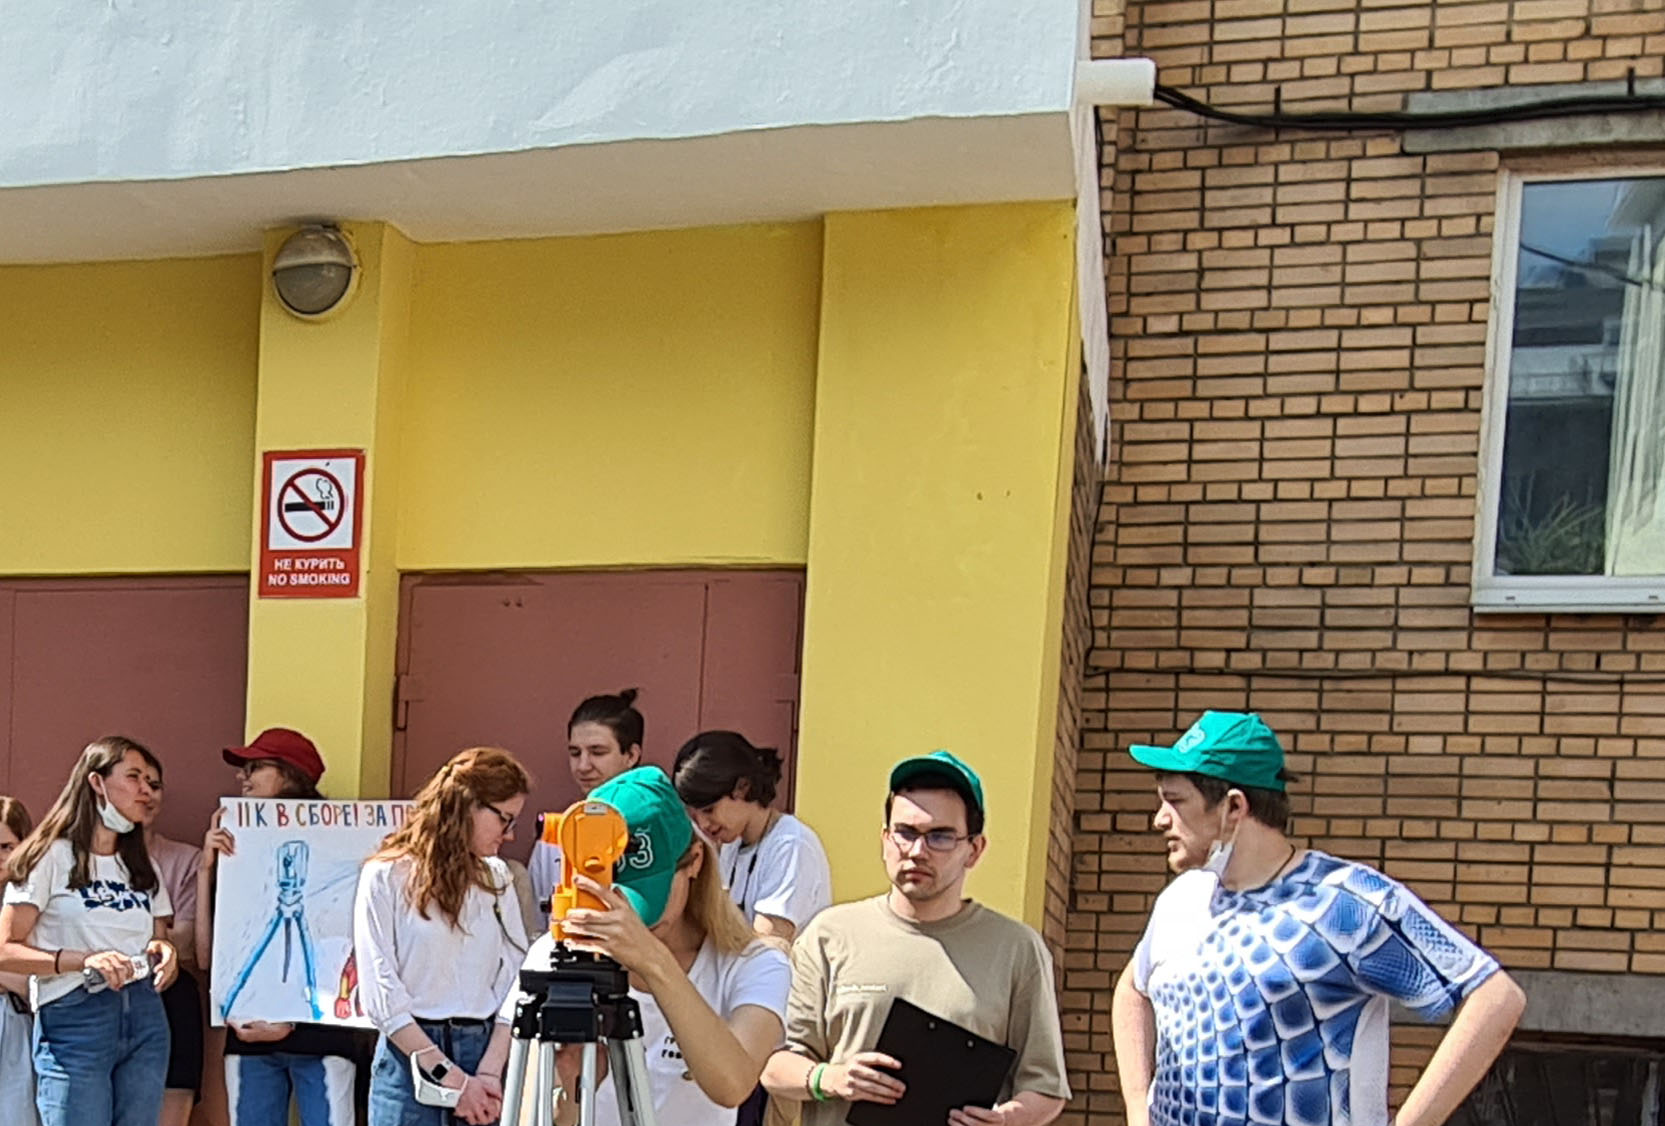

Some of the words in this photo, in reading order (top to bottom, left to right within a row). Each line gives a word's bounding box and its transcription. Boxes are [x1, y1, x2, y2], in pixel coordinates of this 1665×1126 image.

[274, 558, 292, 570] НЕ
[295, 557, 345, 570] КУРИТЬ
[268, 573, 287, 586] NO
[289, 572, 350, 585] SMOKING
[276, 803, 289, 826] В
[296, 803, 358, 826] СБОРЕ!
[364, 804, 387, 827] ЗА
